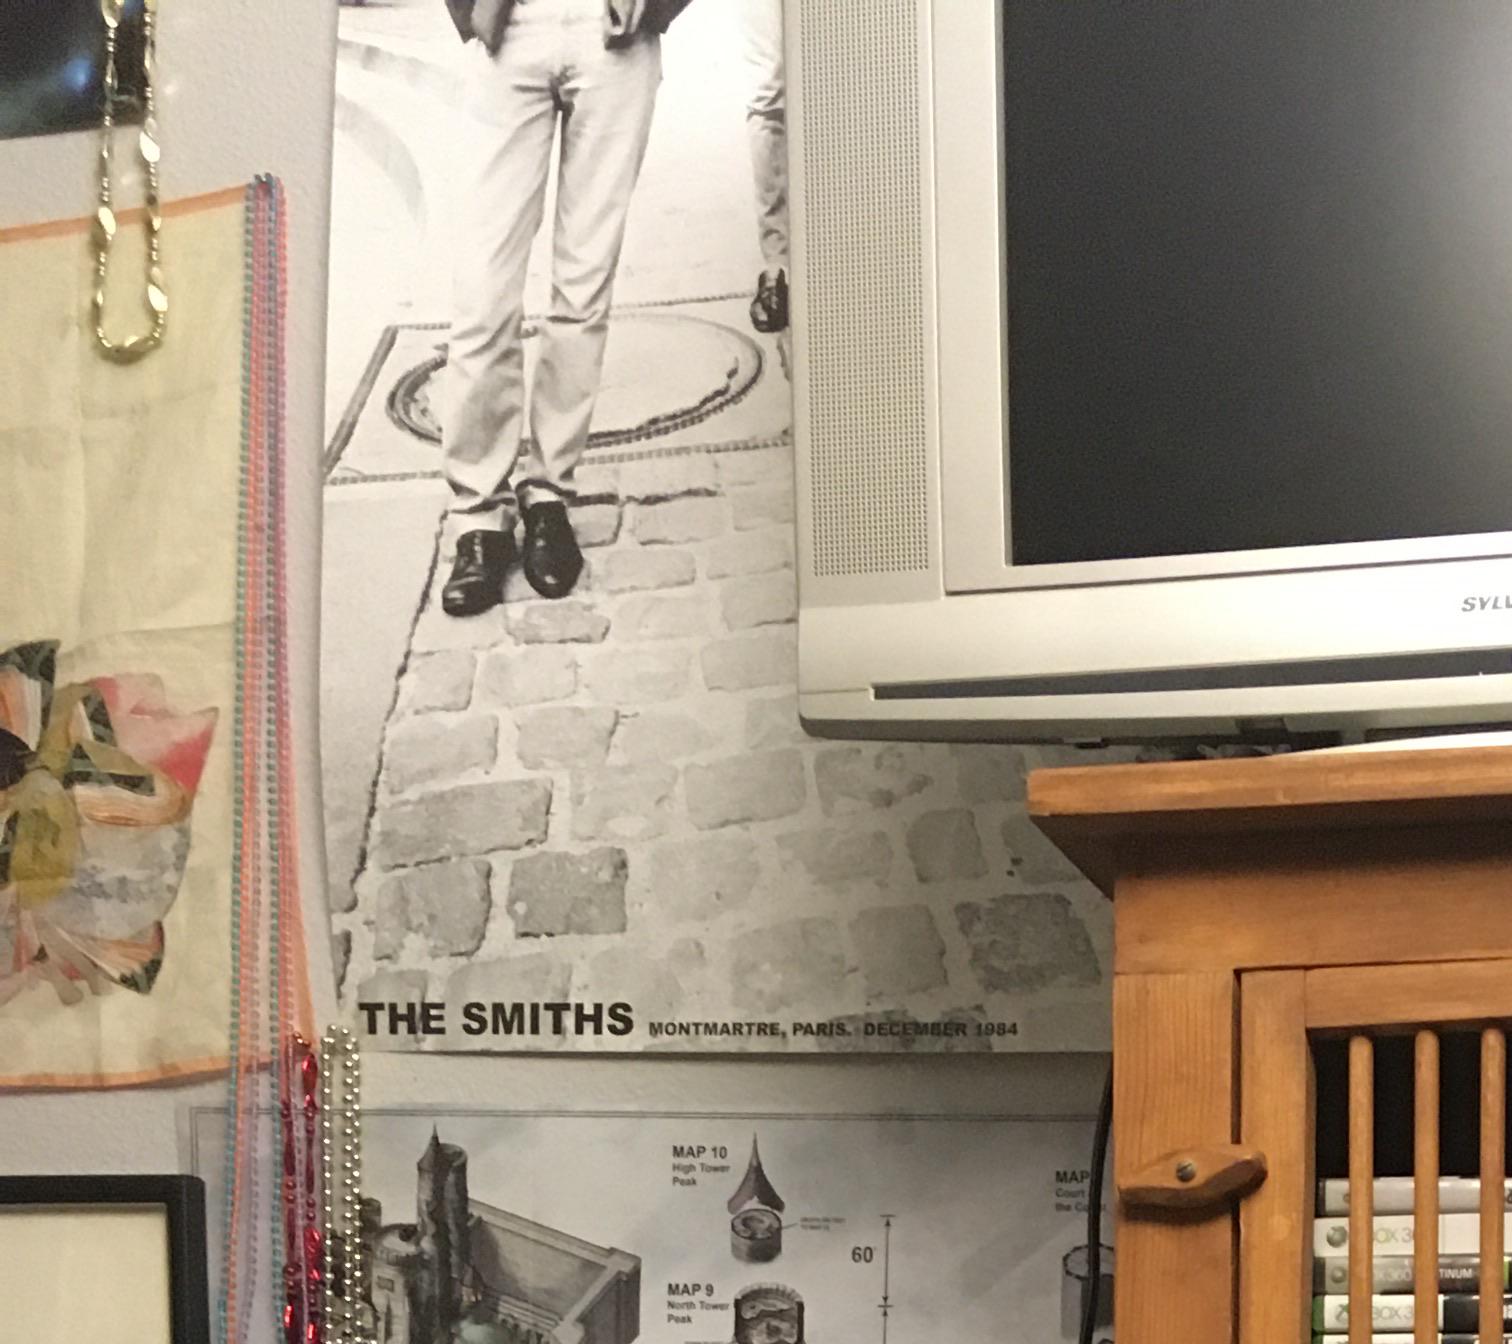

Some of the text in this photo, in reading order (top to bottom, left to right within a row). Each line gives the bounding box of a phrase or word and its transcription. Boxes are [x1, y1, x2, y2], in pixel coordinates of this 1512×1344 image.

[361, 1002, 447, 1035] THE
[462, 1002, 634, 1035] SMITHS
[649, 1021, 788, 1039] MONTMARTRE,
[863, 1021, 967, 1037] DECEMBER
[672, 1145, 728, 1160] MAP 10
[700, 1163, 731, 1174] Tower
[1056, 1170, 1090, 1184] MAP
[667, 1283, 714, 1297] MAP 9
[700, 1301, 730, 1312] Tower
